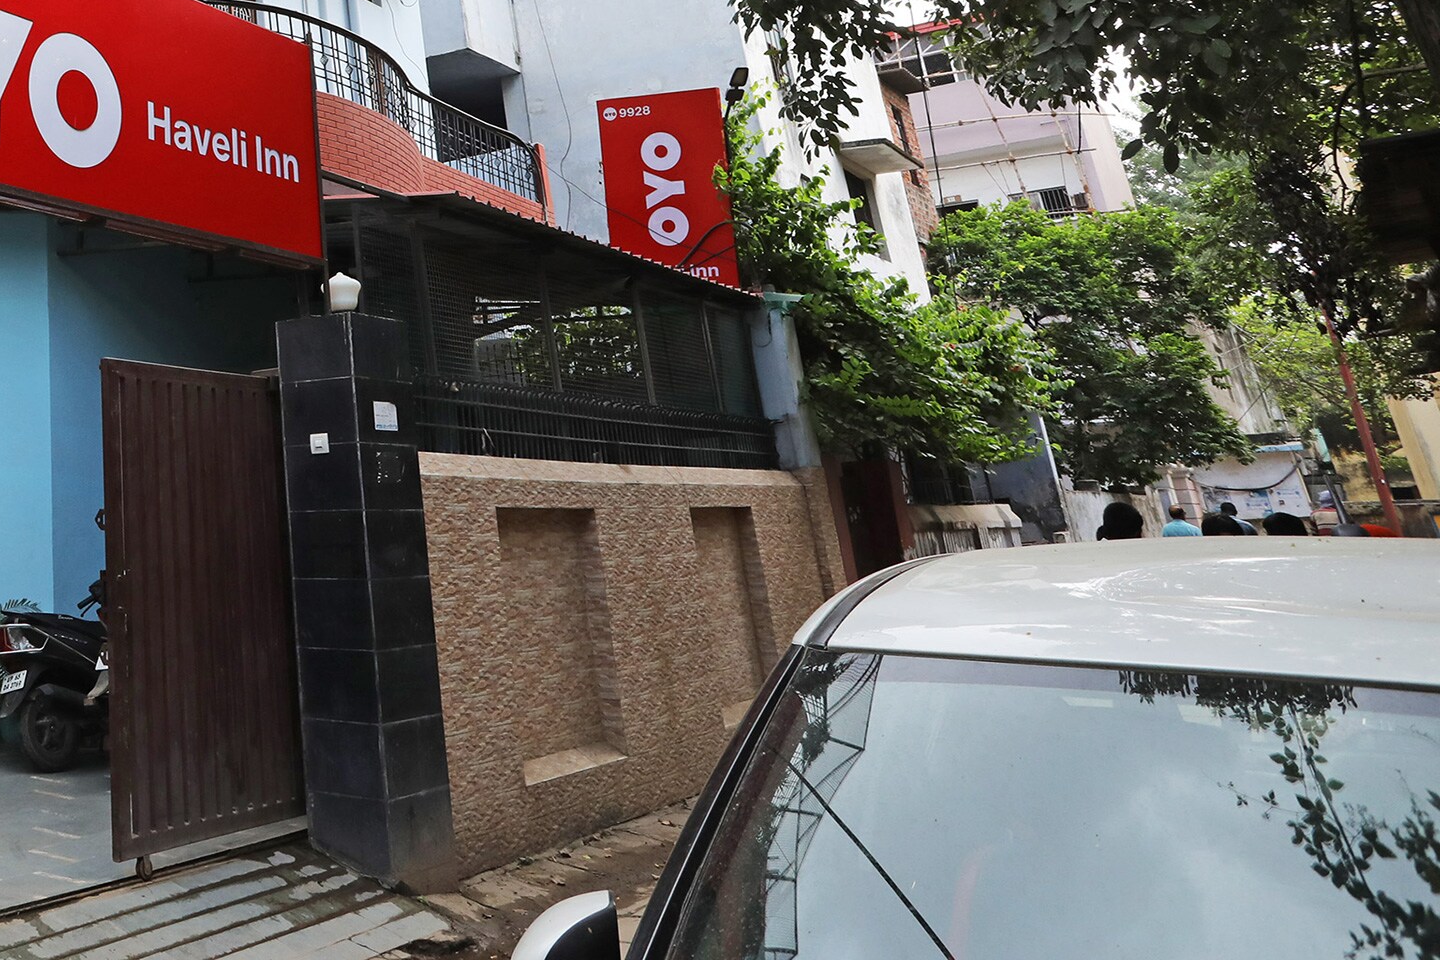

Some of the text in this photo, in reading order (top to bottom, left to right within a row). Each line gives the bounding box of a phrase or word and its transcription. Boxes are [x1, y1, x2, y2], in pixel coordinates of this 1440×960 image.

[146, 100, 301, 184] Haveli Inn
[619, 105, 651, 118] 9928
[640, 131, 690, 247] OYO
